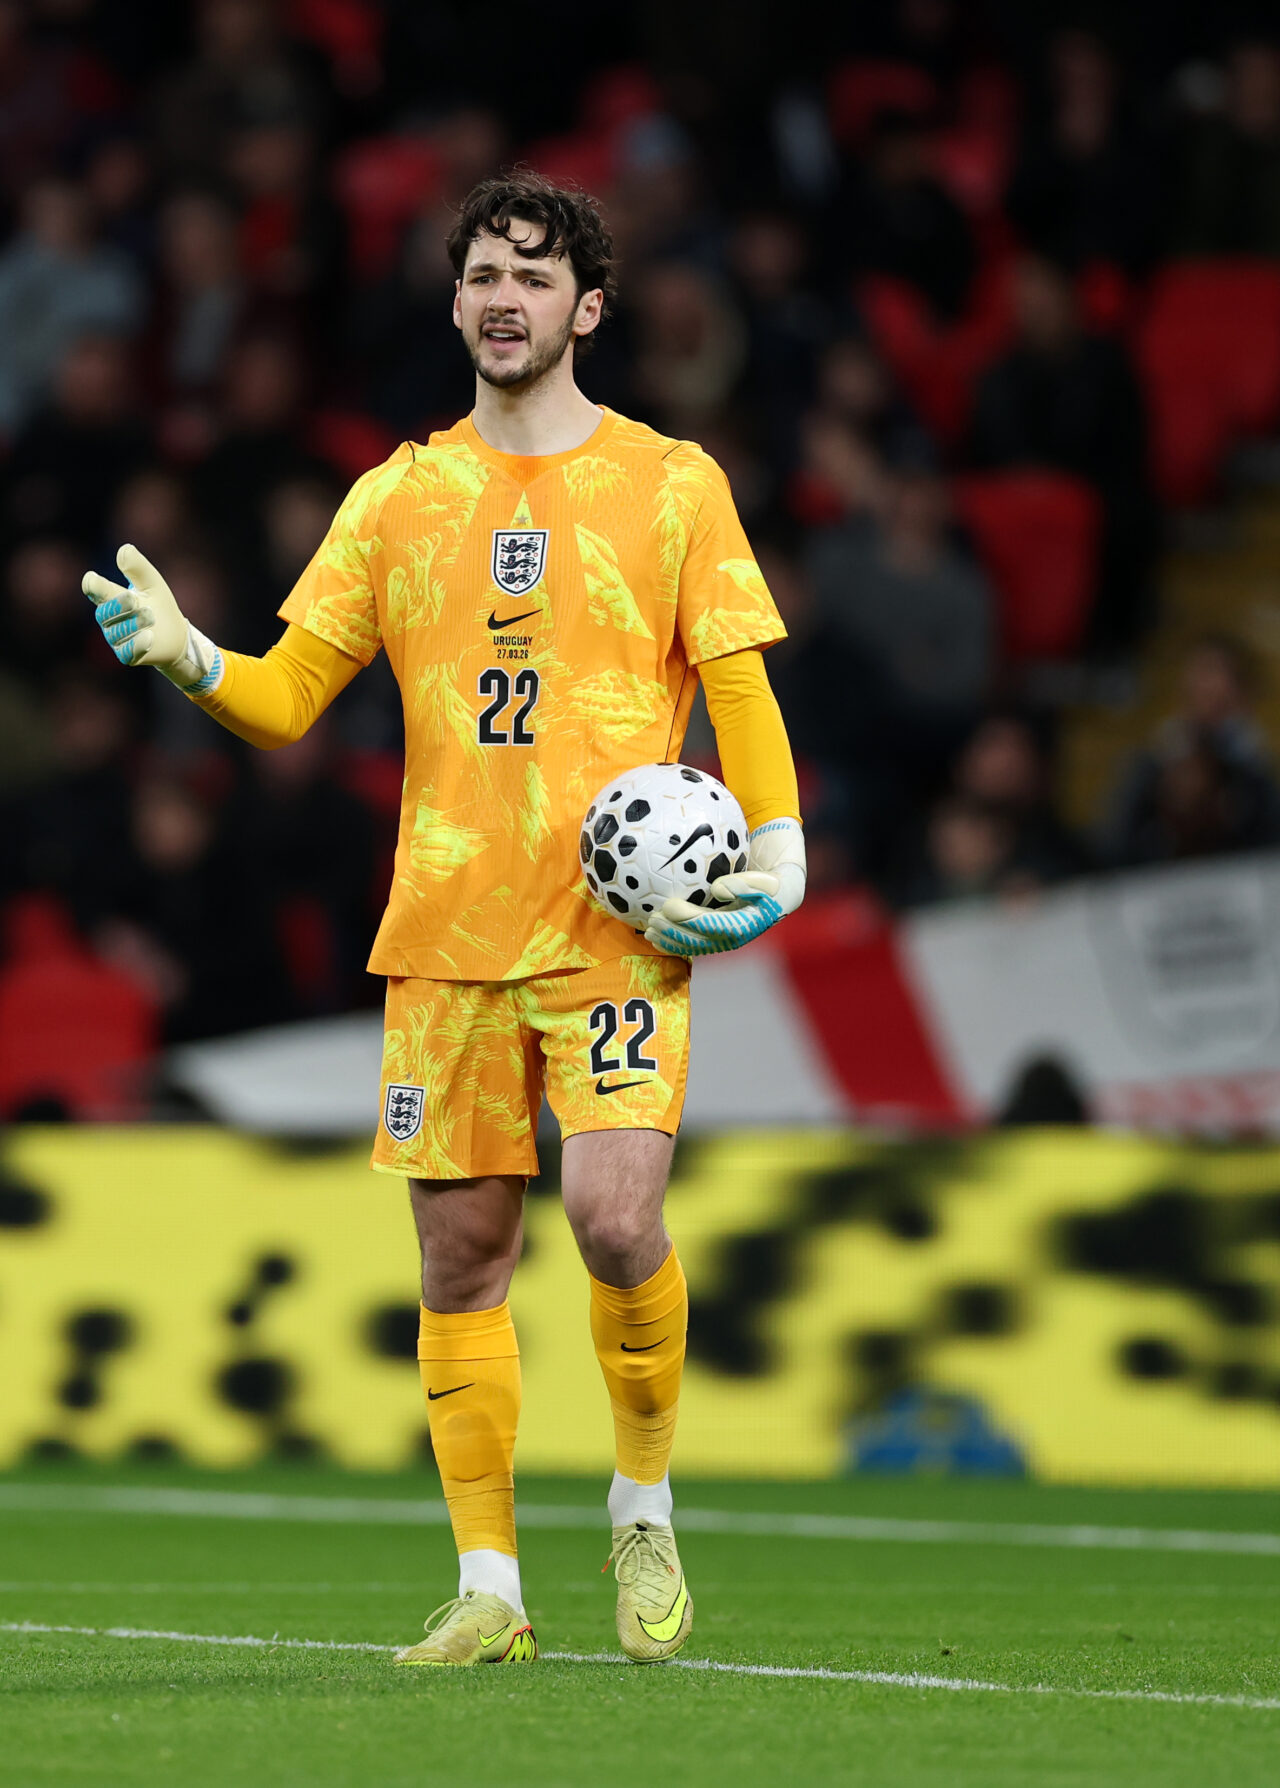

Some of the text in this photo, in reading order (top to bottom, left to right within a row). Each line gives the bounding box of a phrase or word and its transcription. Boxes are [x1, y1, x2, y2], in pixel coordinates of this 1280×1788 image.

[493, 635, 533, 647] URUGUAY
[497, 648, 529, 660] 27.03.26
[477, 667, 540, 746] 22
[588, 998, 658, 1076] 22
